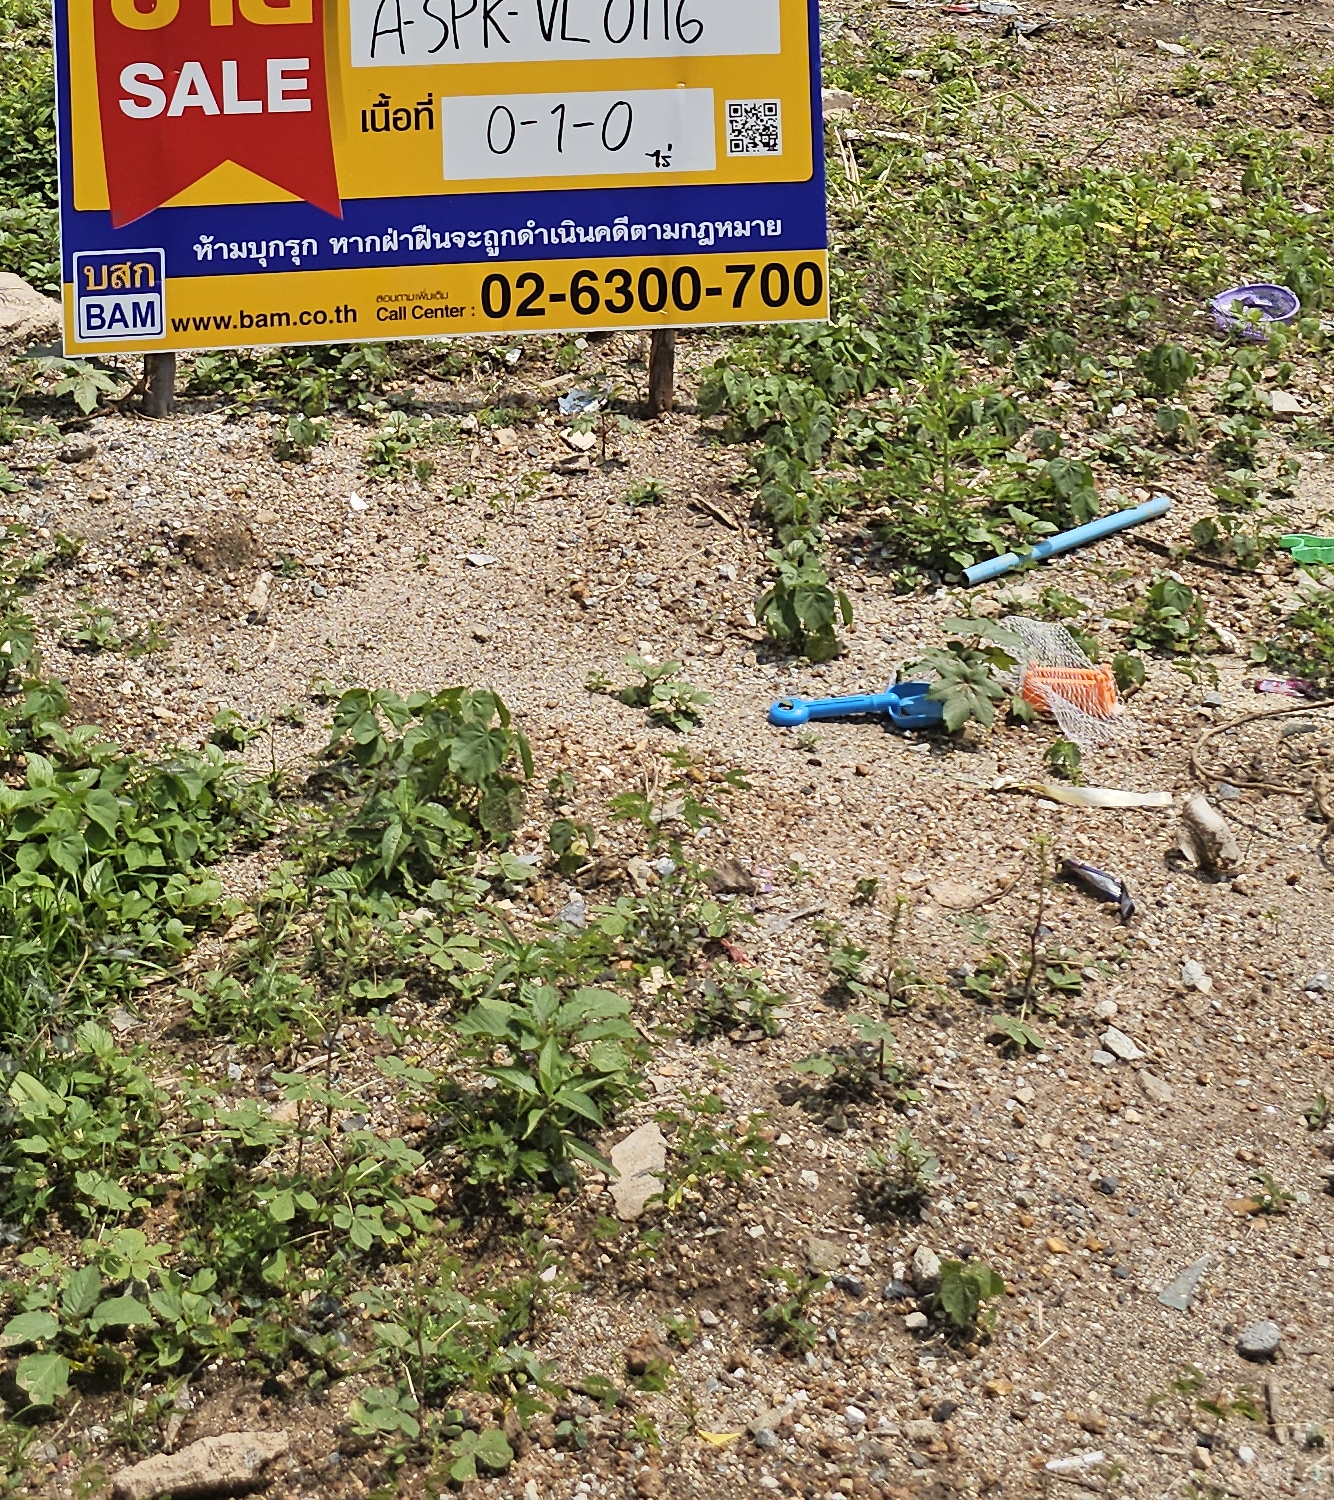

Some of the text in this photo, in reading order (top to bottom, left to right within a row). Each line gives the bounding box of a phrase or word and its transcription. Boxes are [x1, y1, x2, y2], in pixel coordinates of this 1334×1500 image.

[117, 57, 313, 119] SALE
[360, 92, 435, 133] เนื้อที่
[487, 100, 634, 155] 0-1-0
[192, 216, 783, 267] ห้ามบุกรุก หากฝ่าฝืนจะถูกดำเนินคดีตามกฎหมาย
[83, 260, 156, 292] บสก
[376, 306, 407, 322] Call
[411, 305, 467, 320] Center
[480, 261, 824, 319] 02-6300-700
[85, 300, 158, 332] BAM
[171, 304, 358, 333] www.bam.co.th
